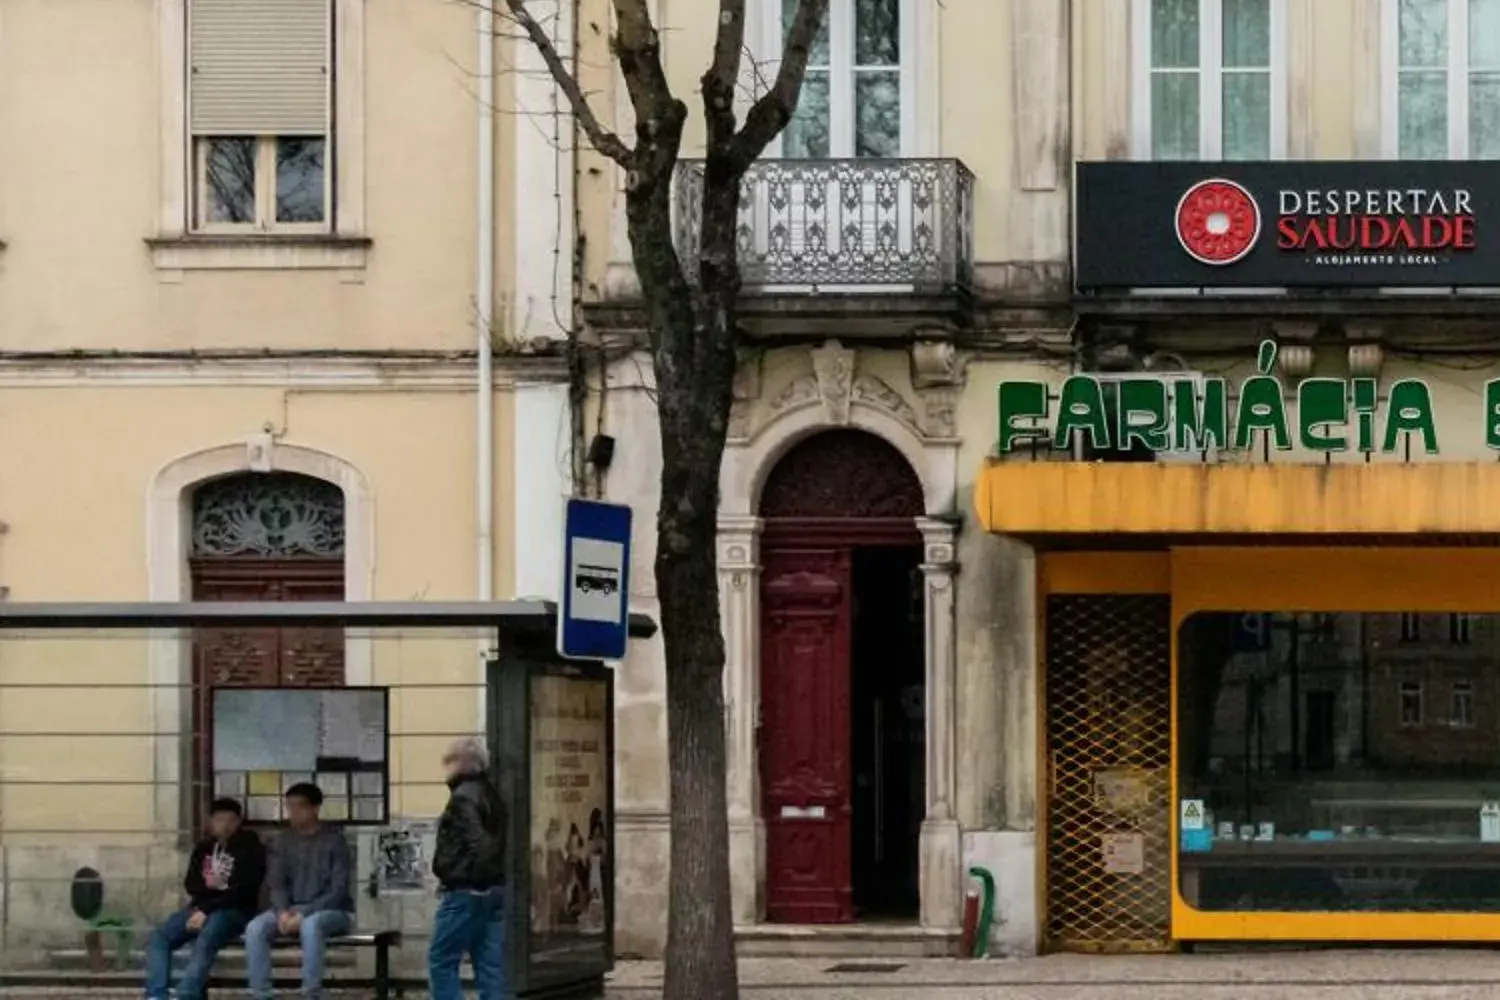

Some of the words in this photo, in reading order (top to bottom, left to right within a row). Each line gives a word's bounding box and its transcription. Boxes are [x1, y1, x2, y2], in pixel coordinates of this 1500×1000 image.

[1279, 189, 1473, 215] DESPERTAR
[1277, 215, 1476, 249] SAUDADE
[1315, 255, 1394, 265] ALOJAMENTO
[1400, 255, 1437, 265] LOCAL
[997, 339, 1439, 453] FARMÁCIA
